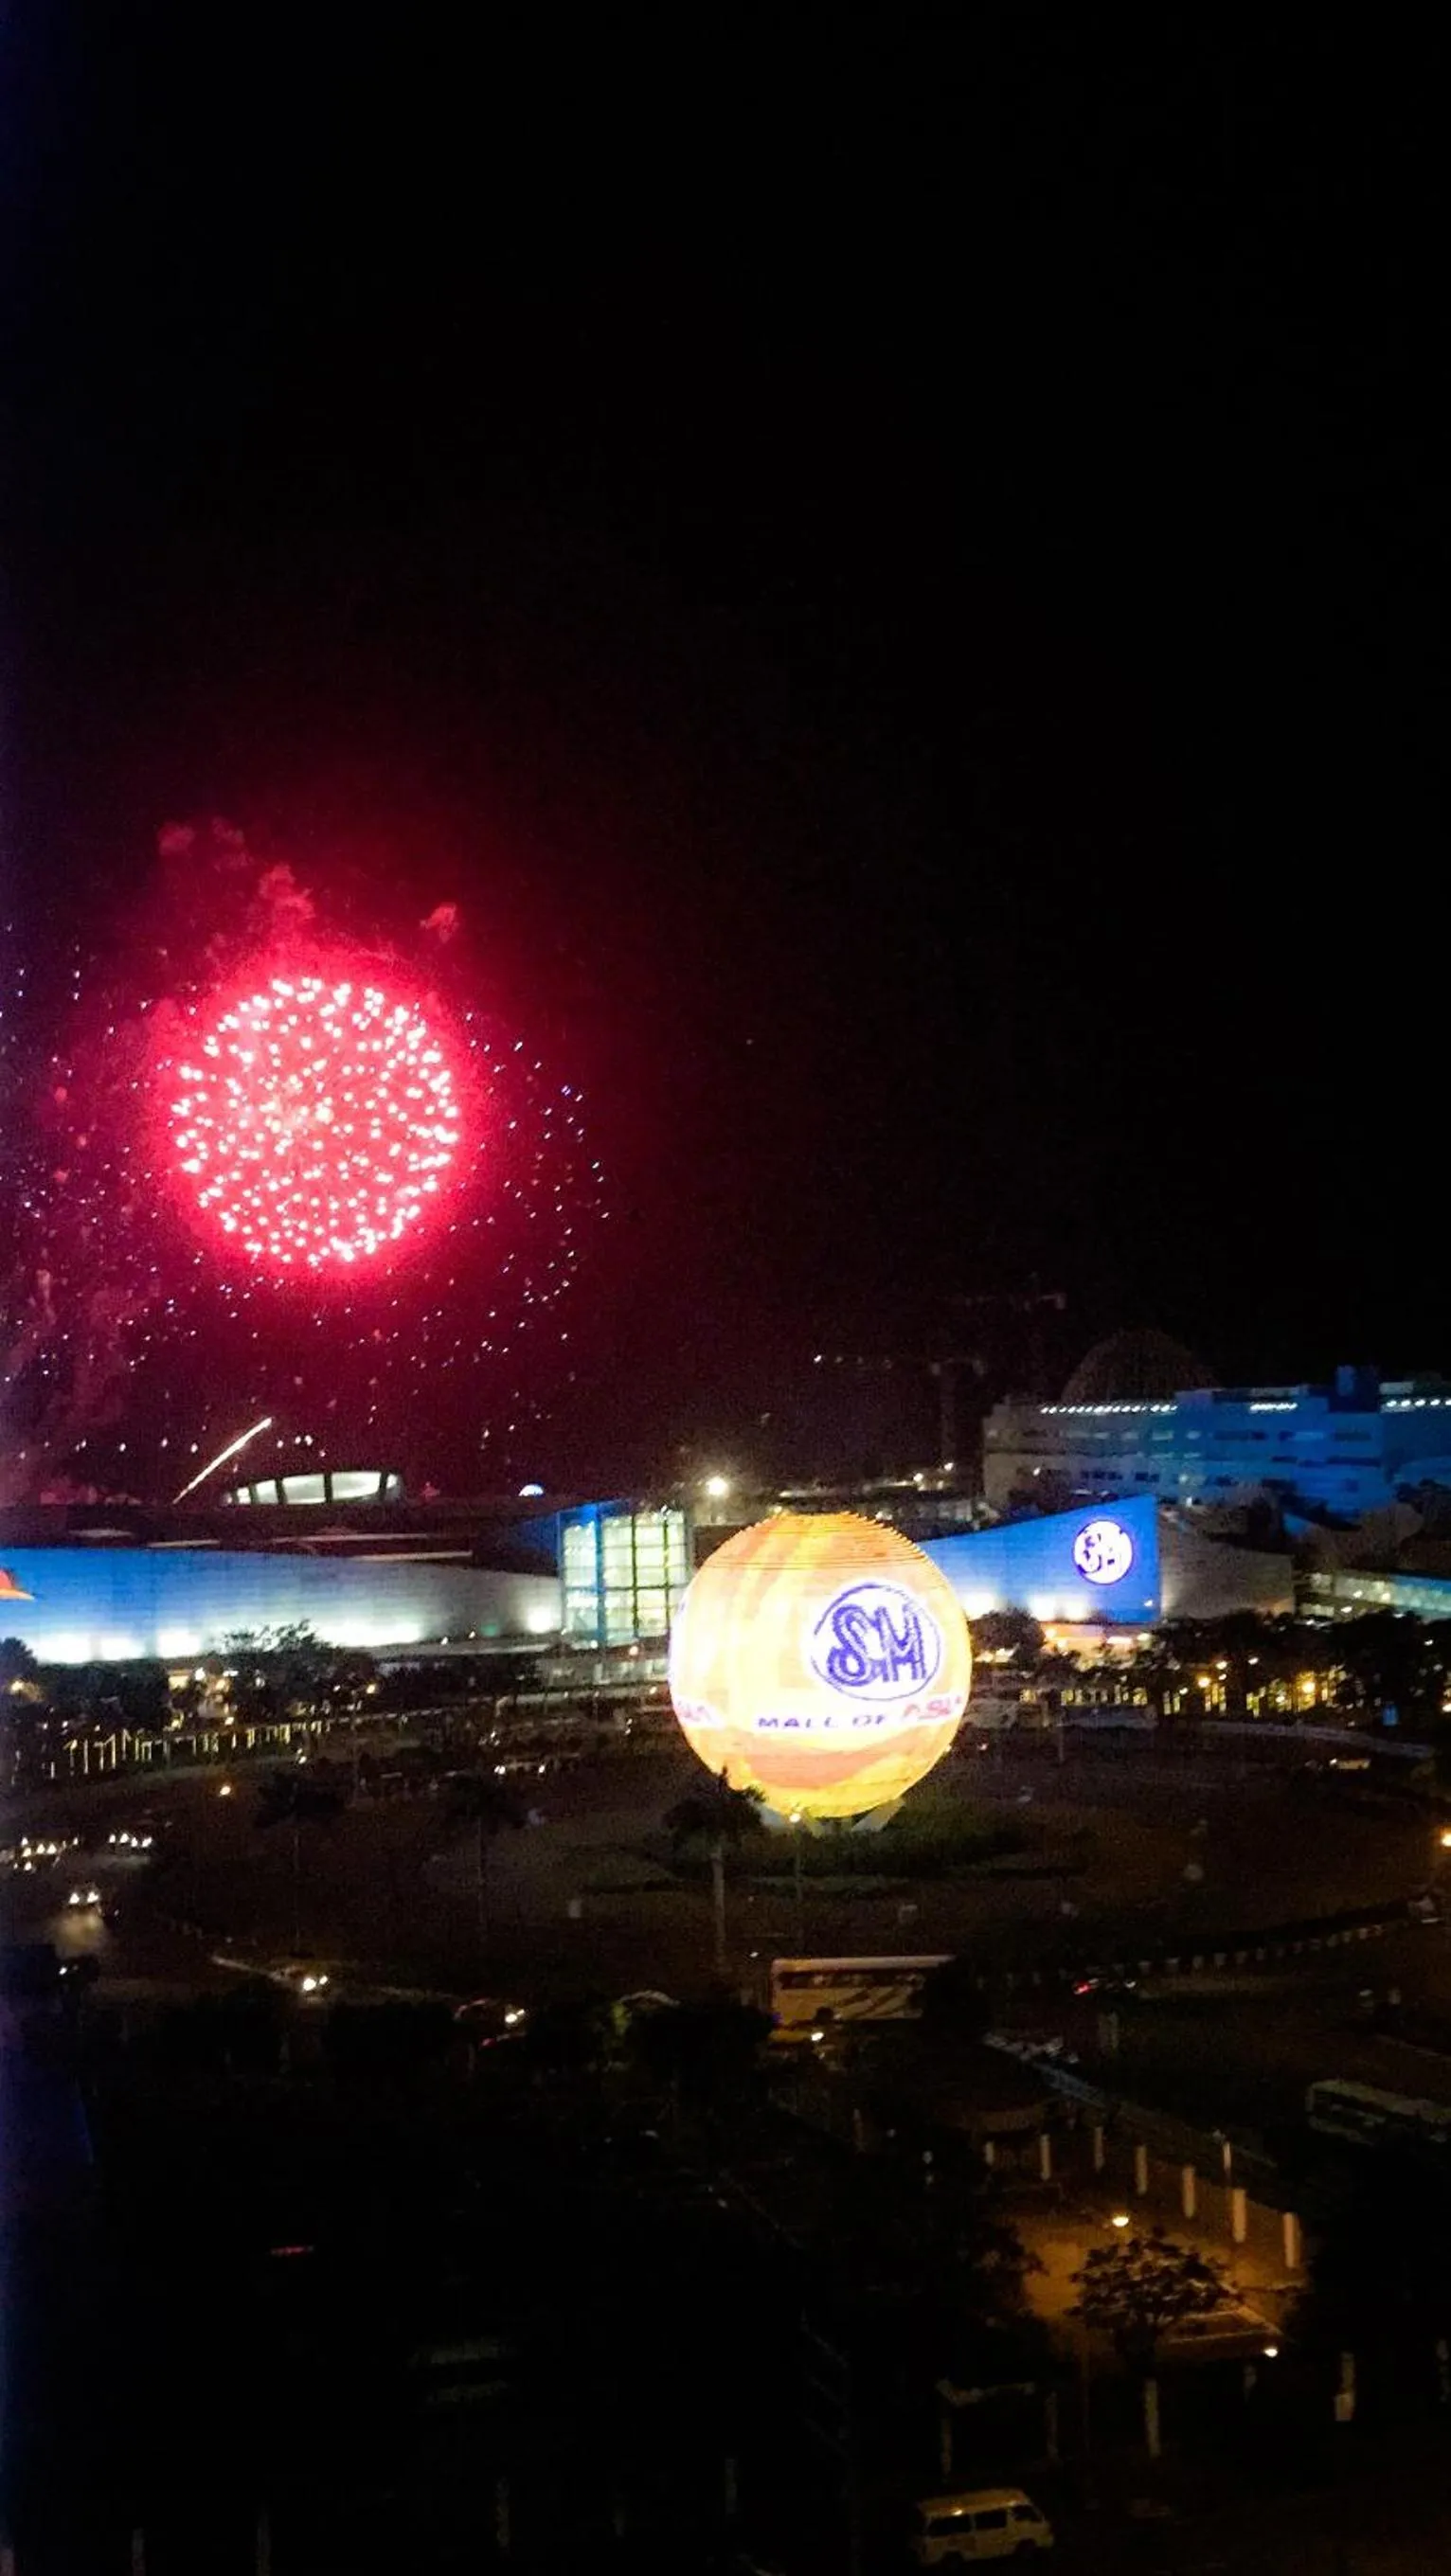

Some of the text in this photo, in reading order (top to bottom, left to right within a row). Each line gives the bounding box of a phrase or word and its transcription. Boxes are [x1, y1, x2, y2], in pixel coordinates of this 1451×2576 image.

[827, 1602, 926, 1687] SM
[758, 1716, 838, 1728] MALL
[851, 1714, 885, 1726] OF
